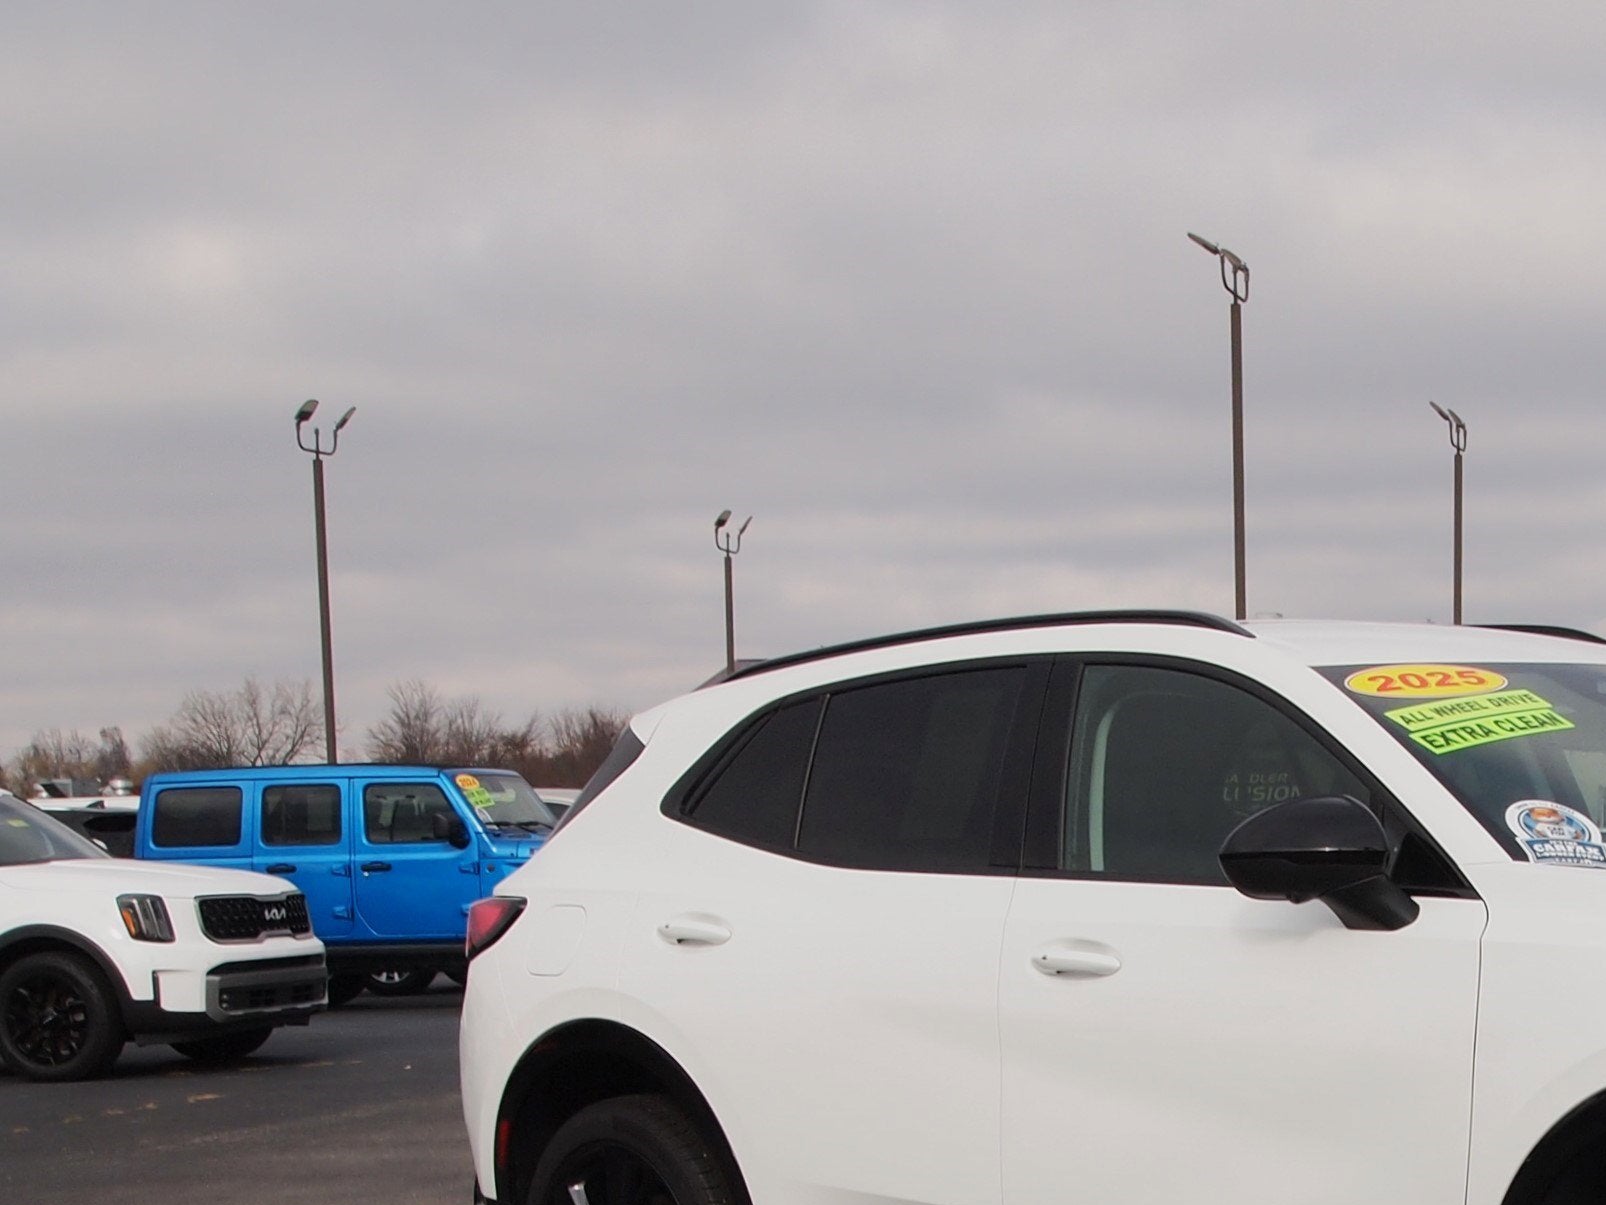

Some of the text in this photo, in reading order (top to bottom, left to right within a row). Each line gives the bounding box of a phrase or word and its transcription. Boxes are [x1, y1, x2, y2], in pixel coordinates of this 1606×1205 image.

[1367, 670, 1489, 693] 2025
[1399, 692, 1540, 726] ALL WHEEL DRIVE
[1420, 711, 1564, 750] EXTRA CLEAN
